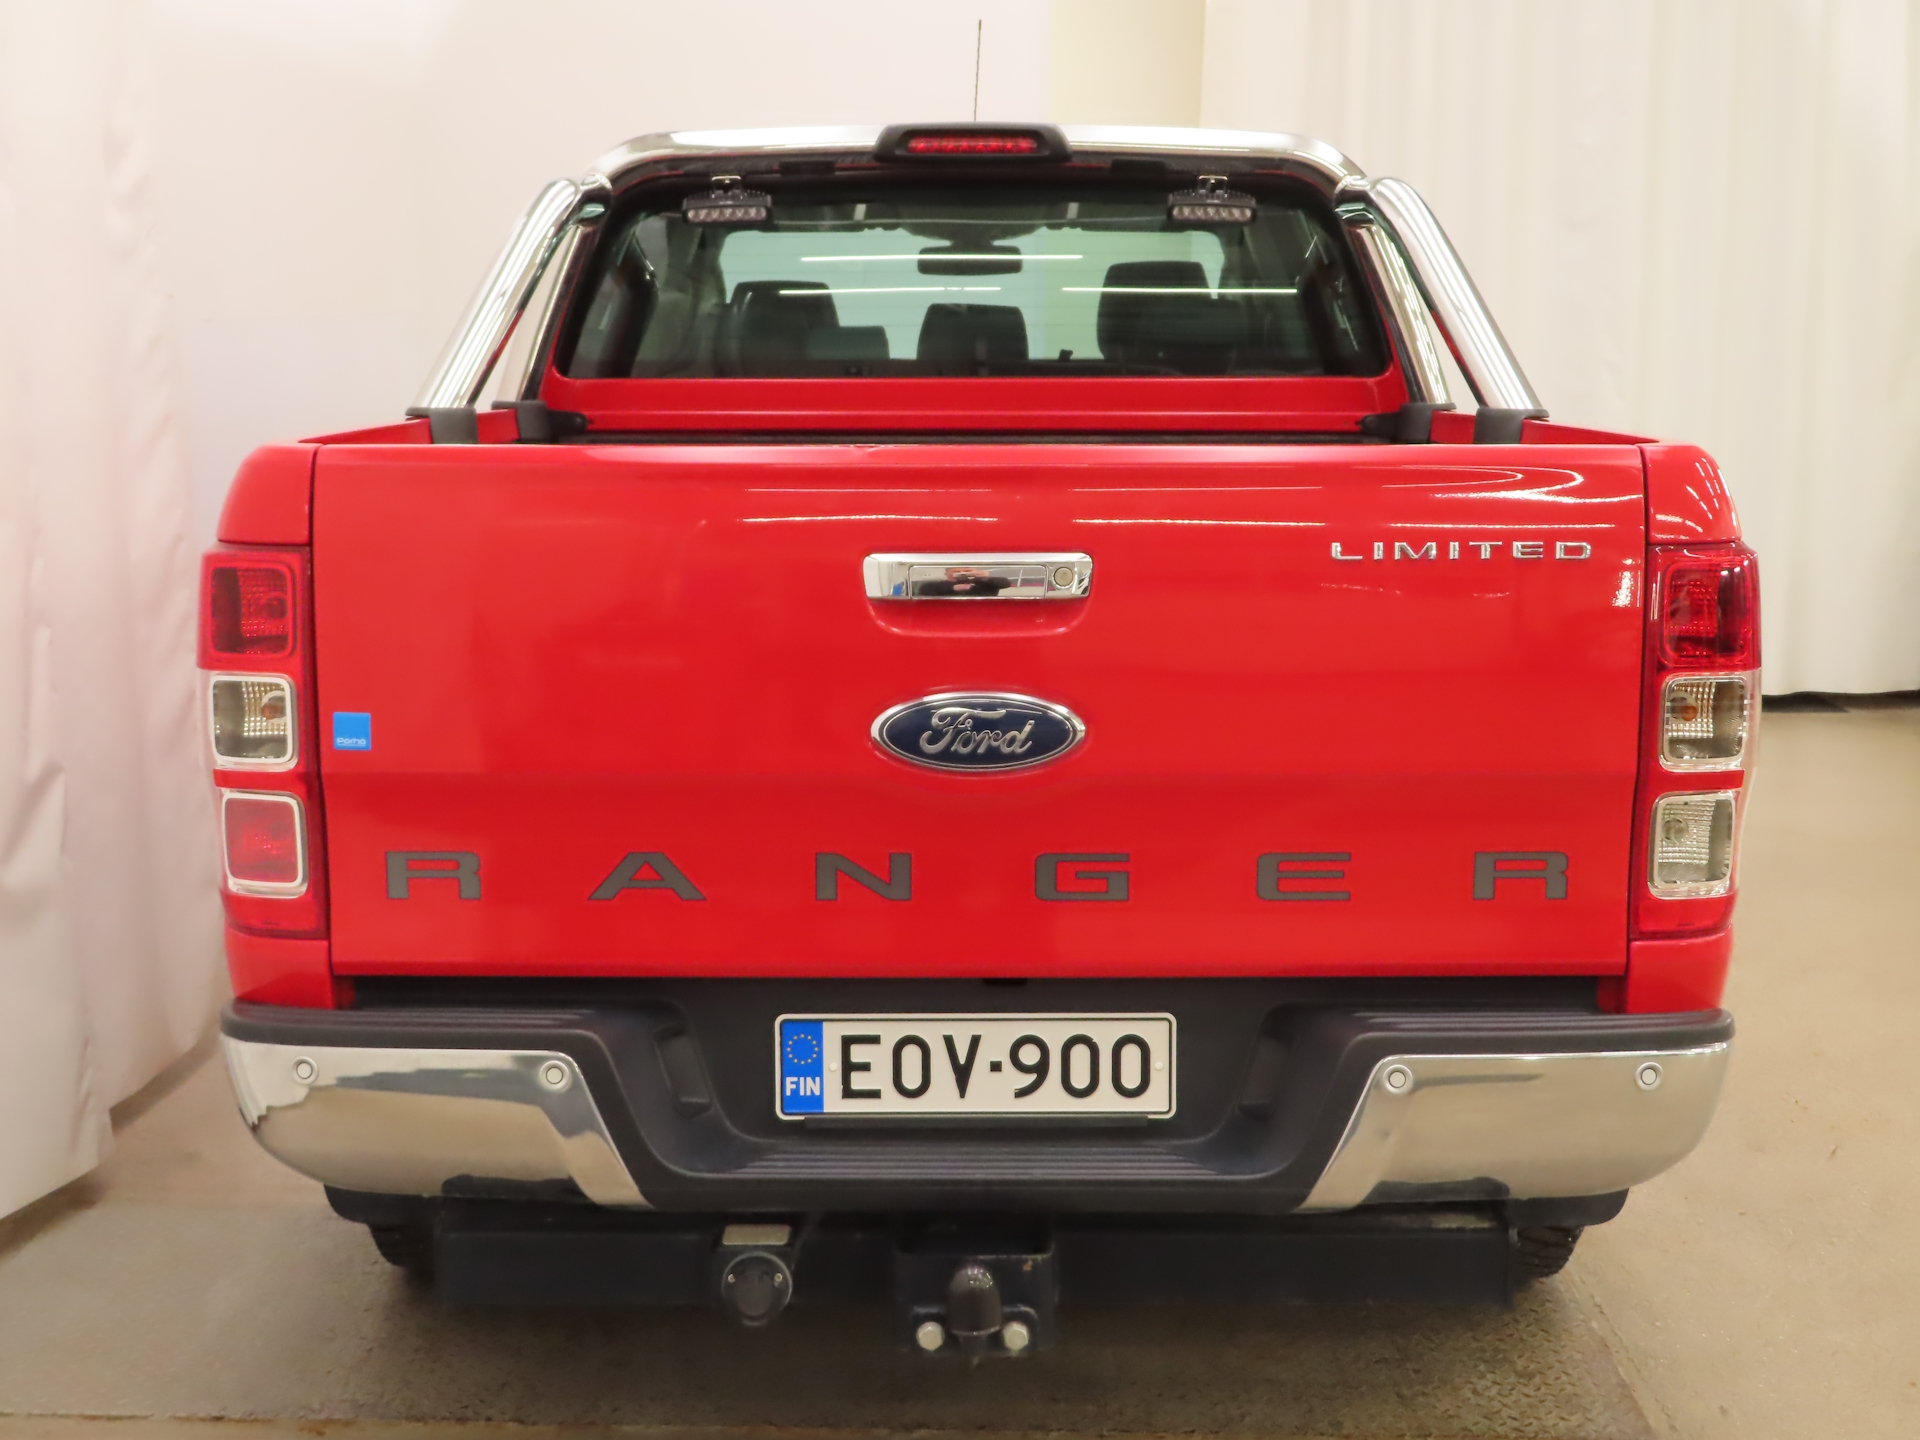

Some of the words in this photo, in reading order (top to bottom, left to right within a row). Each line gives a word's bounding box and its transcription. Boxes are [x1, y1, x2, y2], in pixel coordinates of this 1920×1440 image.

[1331, 541, 1592, 560] LIMITED
[919, 706, 1036, 754] Ford
[385, 851, 1569, 902] RANGER
[785, 1076, 821, 1096] FIN
[841, 1033, 1151, 1099] EOV-900
